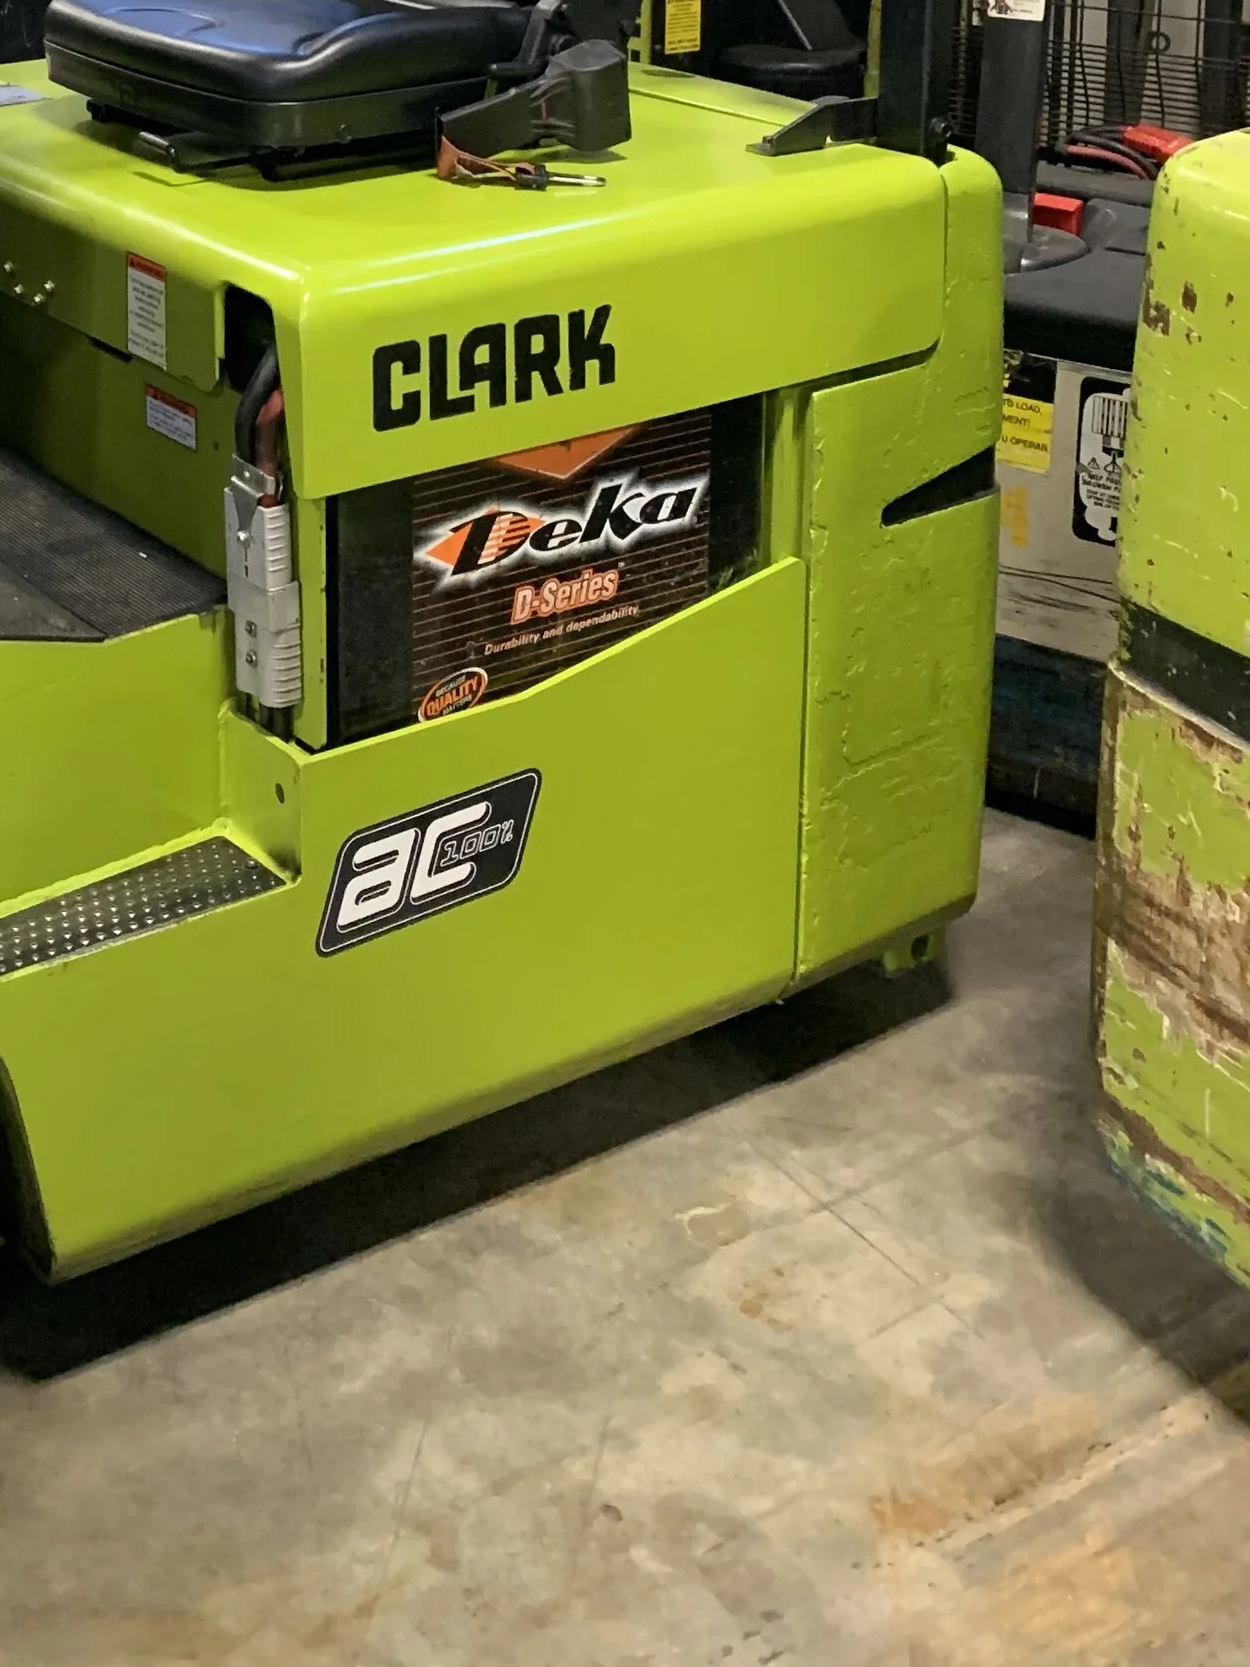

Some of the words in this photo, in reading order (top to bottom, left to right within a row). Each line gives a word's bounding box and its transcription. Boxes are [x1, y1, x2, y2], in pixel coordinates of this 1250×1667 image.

[371, 303, 617, 432] CLARK
[448, 480, 699, 577] Deka
[510, 569, 619, 625] D-Series
[484, 631, 540, 656] Durability
[542, 624, 563, 640] and
[565, 605, 639, 633] dependability
[426, 674, 479, 717] QUALITY
[440, 819, 515, 867] 100%
